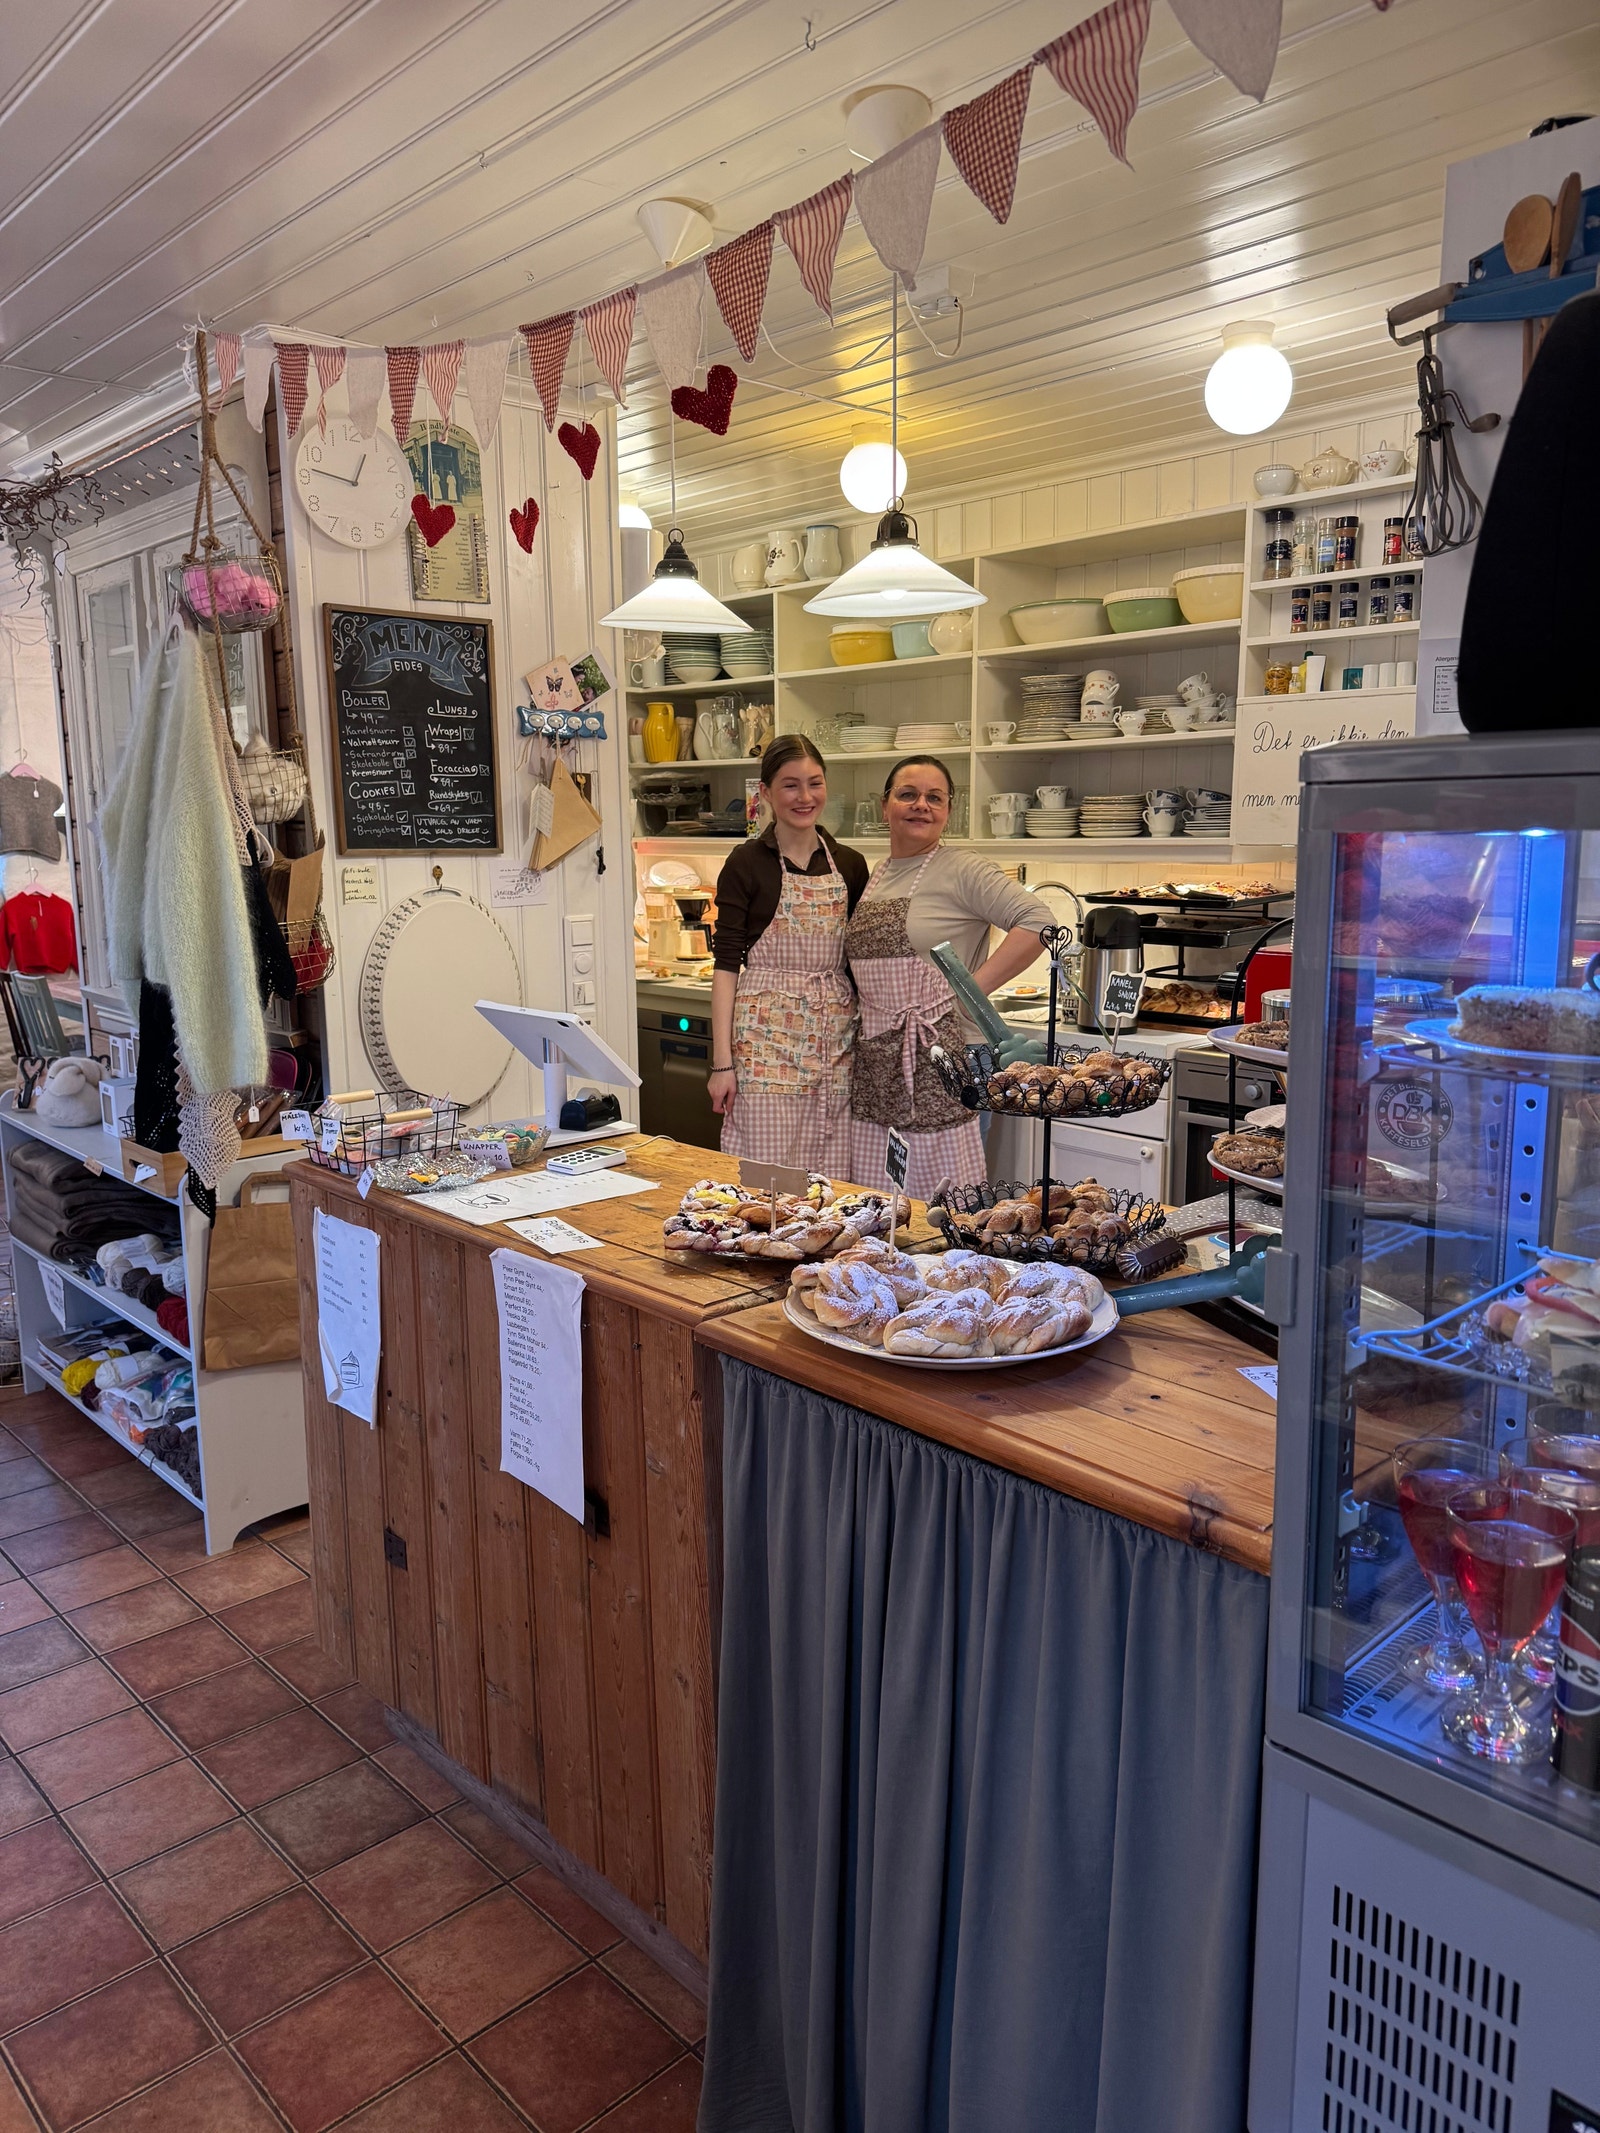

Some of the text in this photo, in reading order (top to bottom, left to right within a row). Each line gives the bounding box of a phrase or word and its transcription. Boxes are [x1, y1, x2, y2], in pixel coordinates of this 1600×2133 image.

[304, 444, 323, 463] 10
[387, 456, 399, 473] 2
[299, 468, 310, 485] 9
[395, 483, 405, 499] 3
[308, 495, 320, 512] 8
[327, 515, 340, 533] 7
[374, 522, 385, 539] 5
[351, 526, 361, 542] 6
[368, 623, 457, 663] MENY
[394, 660, 423, 672] EIDES
[341, 689, 386, 708] BOLLER
[345, 725, 397, 736] Kanelsnurr
[427, 723, 460, 739] Wraps
[1252, 720, 1293, 753] Det
[1300, 734, 1321, 749] er
[1378, 719, 1409, 740] den
[351, 759, 390, 769] Skolebolle
[430, 758, 471, 773] Focaccia
[351, 769, 394, 778] Kremsnurr
[348, 781, 396, 800] COOKIES
[1241, 793, 1275, 808] men
[356, 812, 395, 824] Sjokolade
[1110, 976, 1134, 990] KANEL
[1382, 1086, 1399, 1103] DET
[463, 1143, 502, 1151] KNAPPER
[502, 1264, 513, 1273] Peer
[513, 1267, 525, 1277] Gynt
[503, 1282, 518, 1292] Smart
[504, 1301, 522, 1312] Perfect
